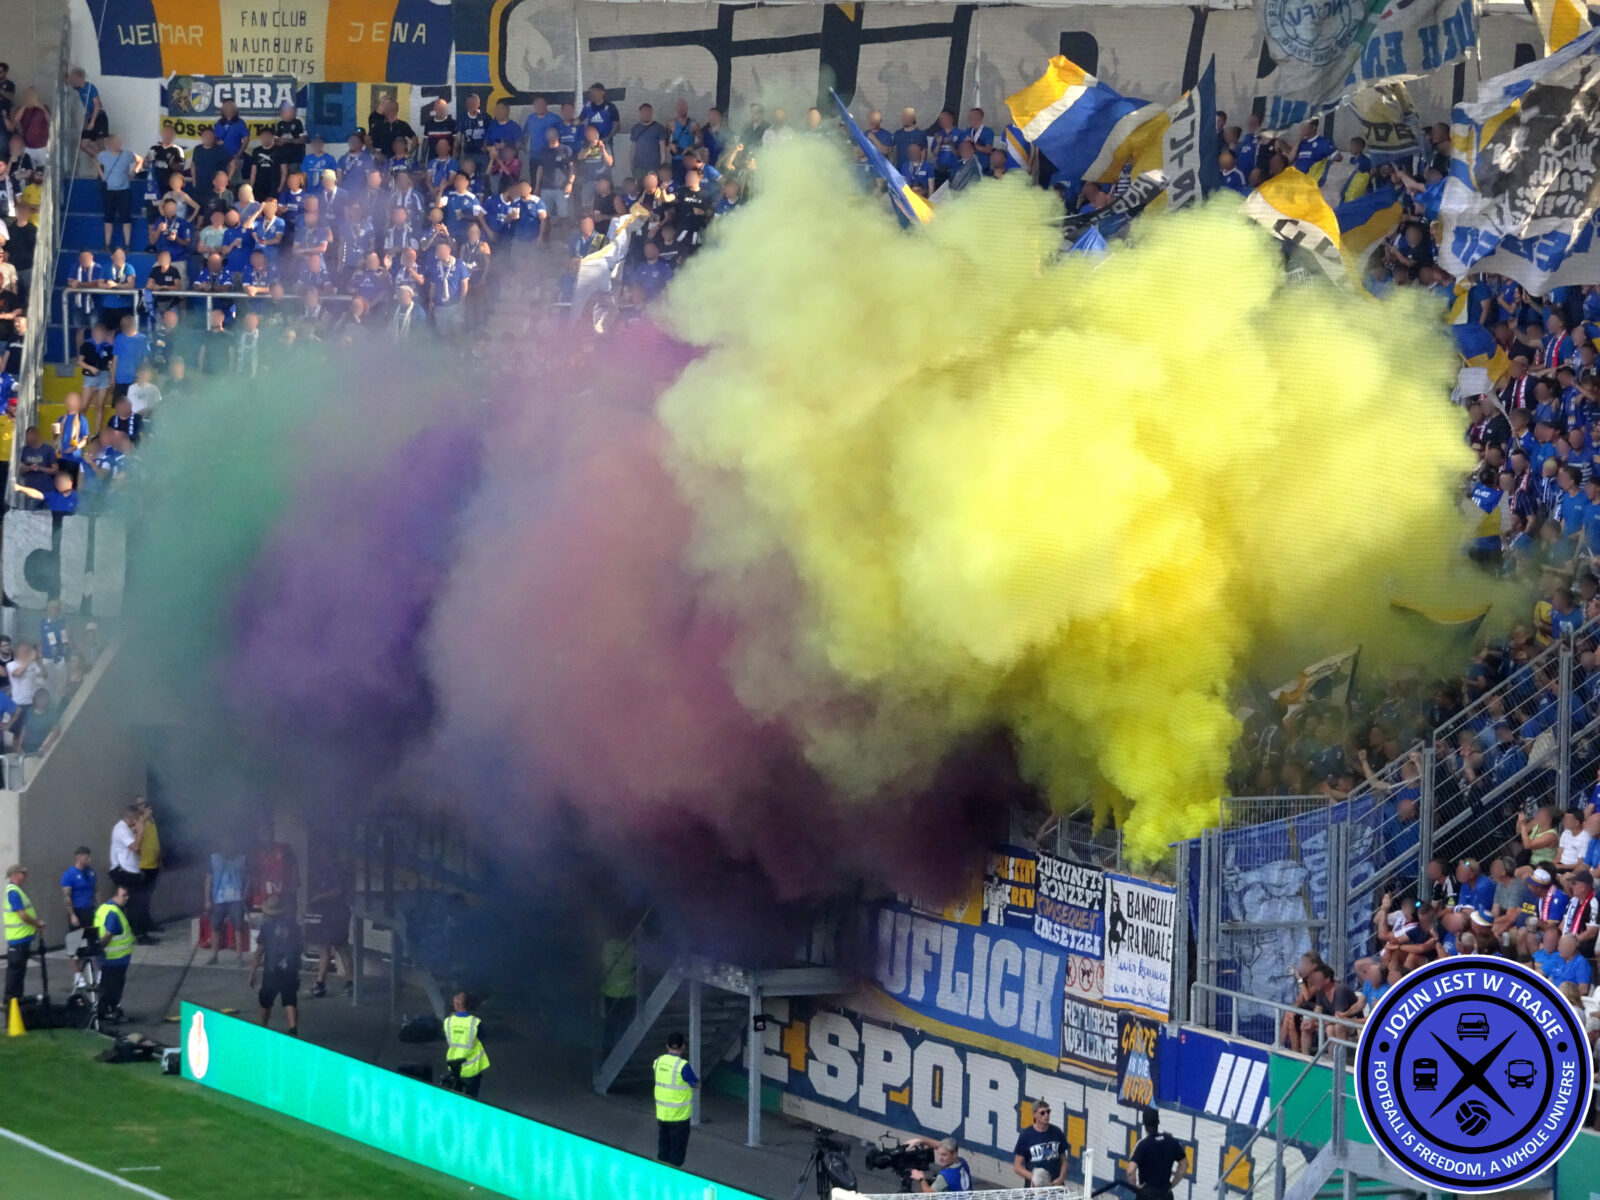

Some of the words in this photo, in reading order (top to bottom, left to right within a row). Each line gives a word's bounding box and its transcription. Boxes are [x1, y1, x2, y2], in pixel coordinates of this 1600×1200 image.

[118, 22, 204, 46] WEIMAR
[241, 10, 268, 28] FAN
[272, 10, 308, 28] CLUB
[348, 21, 427, 45] JENA
[230, 36, 314, 54] NAUMBURG
[227, 58, 274, 74] UNITED
[278, 58, 316, 75] CITYS
[213, 82, 295, 109] GERA
[1036, 852, 1104, 891] ZUKUNFTS
[1038, 872, 1101, 911] KONZEPT
[1127, 921, 1171, 963] RANDALE
[874, 907, 1061, 1040] UFLICH
[1064, 998, 1118, 1038] REFUGEES
[1063, 1025, 1118, 1066] WELCOME
[1121, 1018, 1158, 1059] GÄSTE
[1122, 1074, 1154, 1106] NORD
